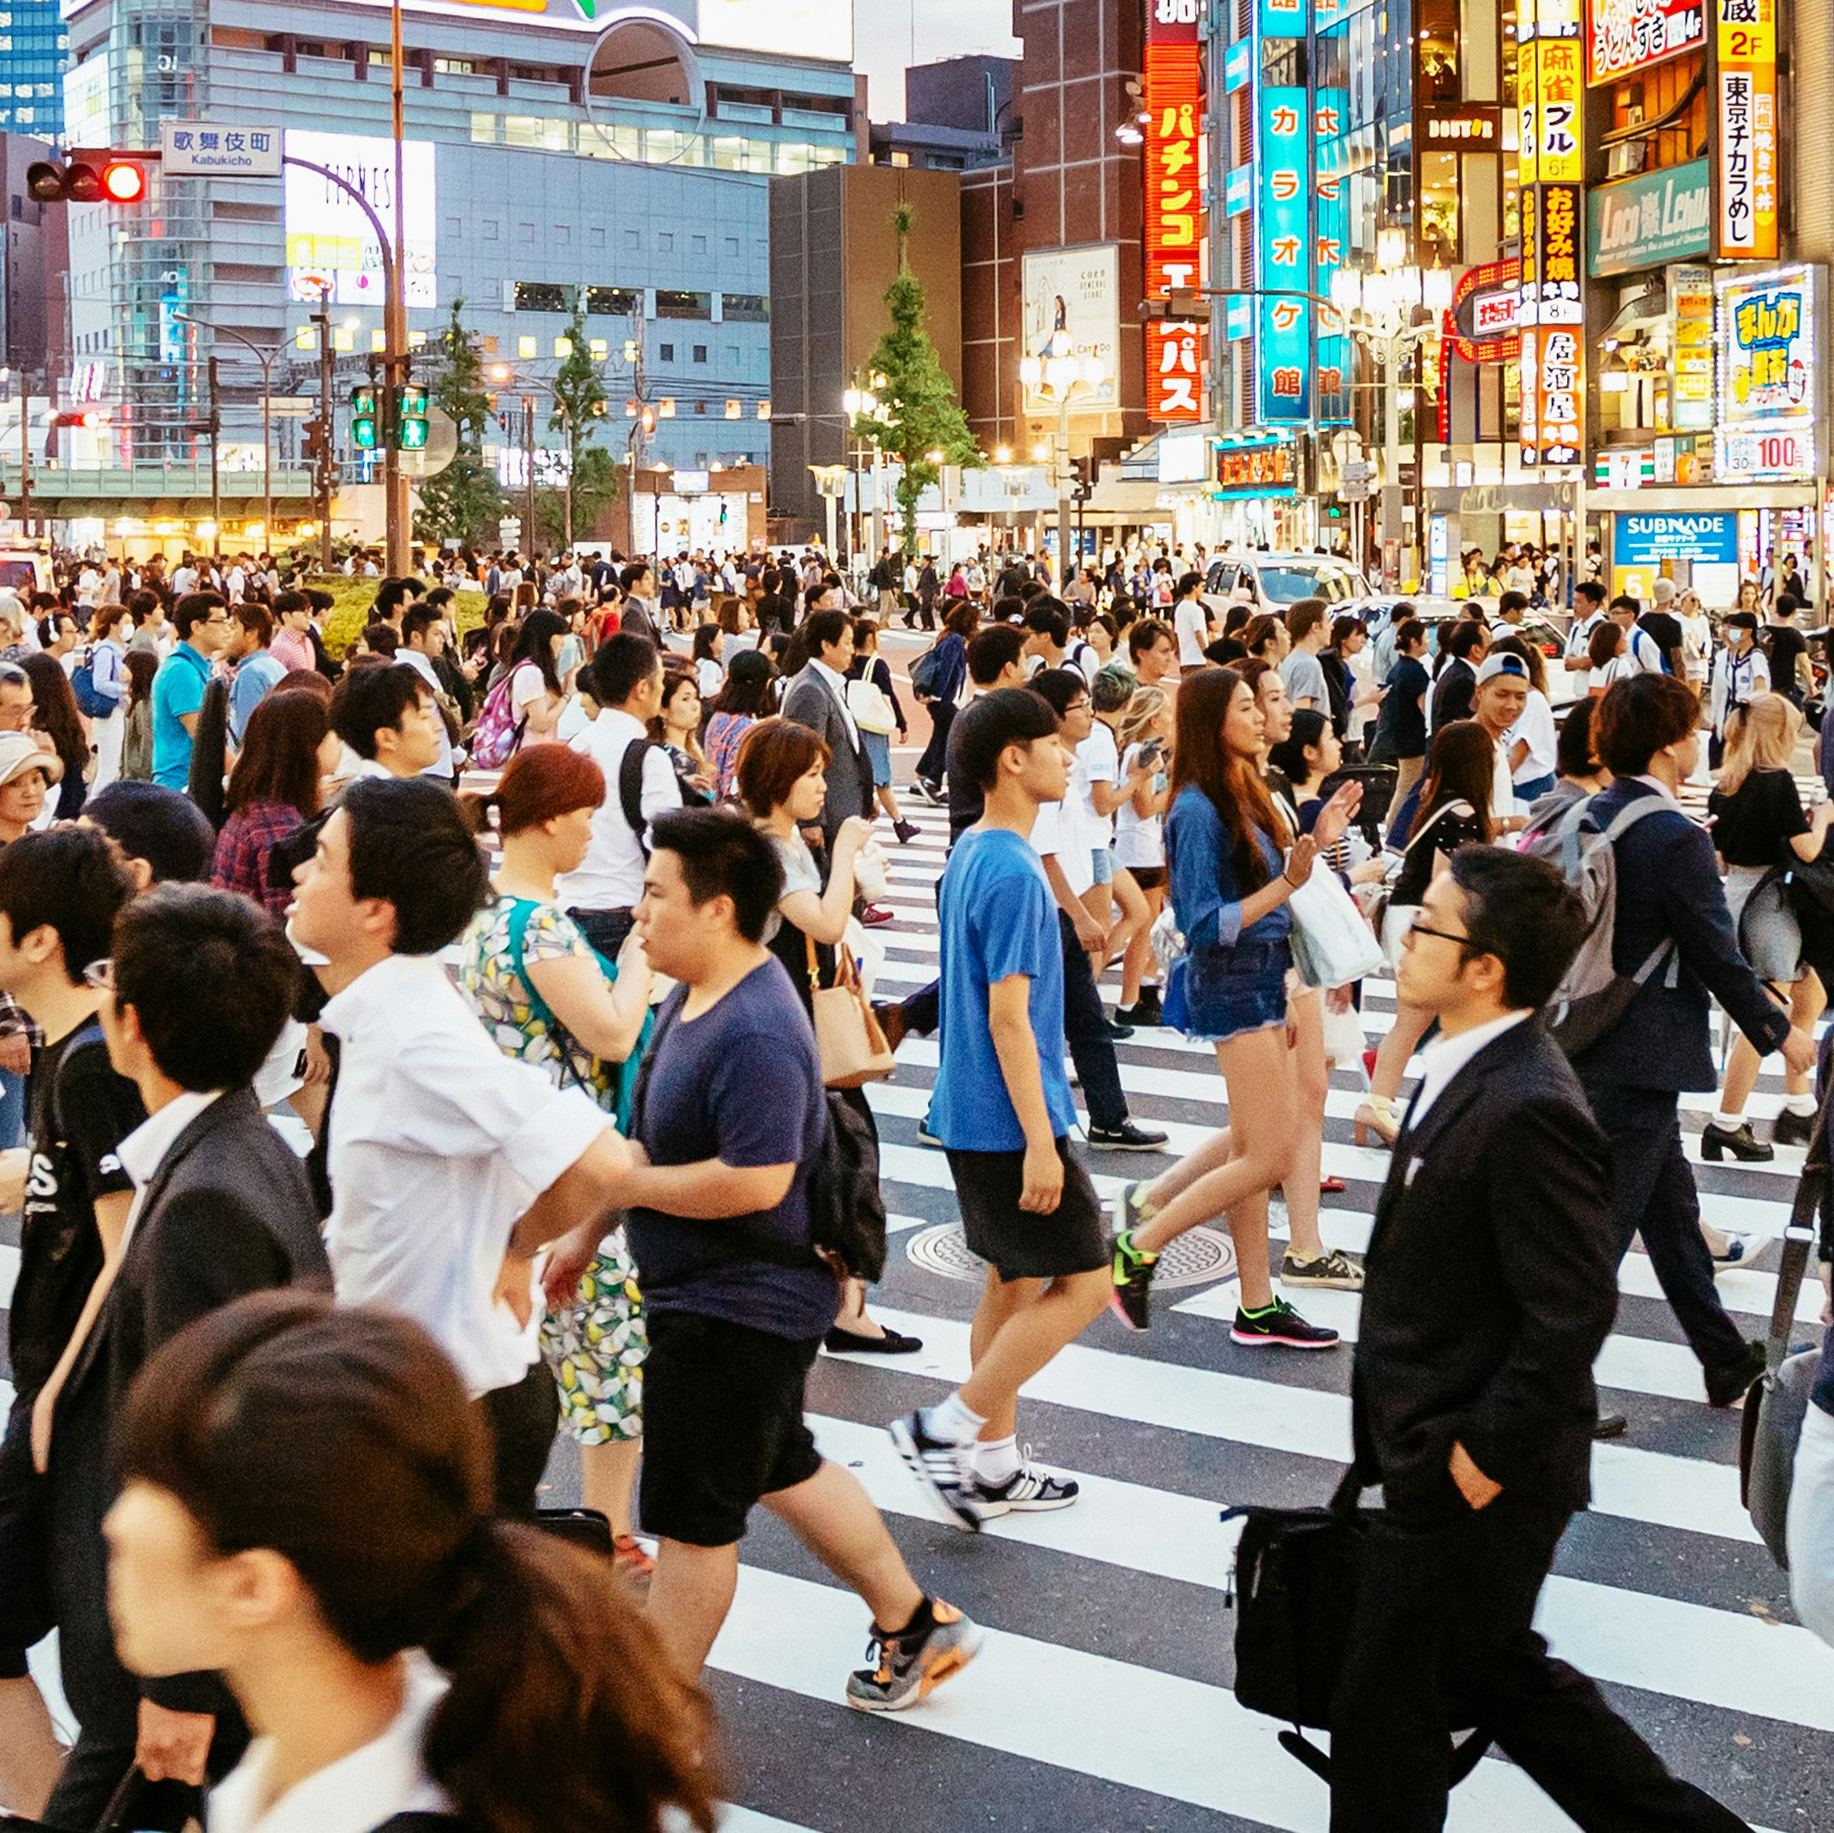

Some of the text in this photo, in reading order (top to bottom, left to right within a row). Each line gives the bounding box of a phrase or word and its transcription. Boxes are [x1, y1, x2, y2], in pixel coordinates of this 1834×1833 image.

[1593, 14, 1666, 76] うどんすき
[1729, 30, 1764, 57] 2F
[173, 131, 271, 153] 歌舞伎町
[1428, 118, 1495, 140] DOUTOR
[191, 153, 253, 167] Kabukicho
[1157, 103, 1196, 247] パチンコ
[1548, 160, 1570, 177] 6F
[1725, 77, 1752, 242] 東京チカラめし
[1270, 105, 1304, 396] カラオケ館
[1545, 187, 1575, 281] お好み焼
[1737, 297, 1800, 346] まんが
[1543, 332, 1577, 423] 居酒屋
[1626, 517, 1725, 535] SUBNADE
[1625, 574, 1642, 597] 5
